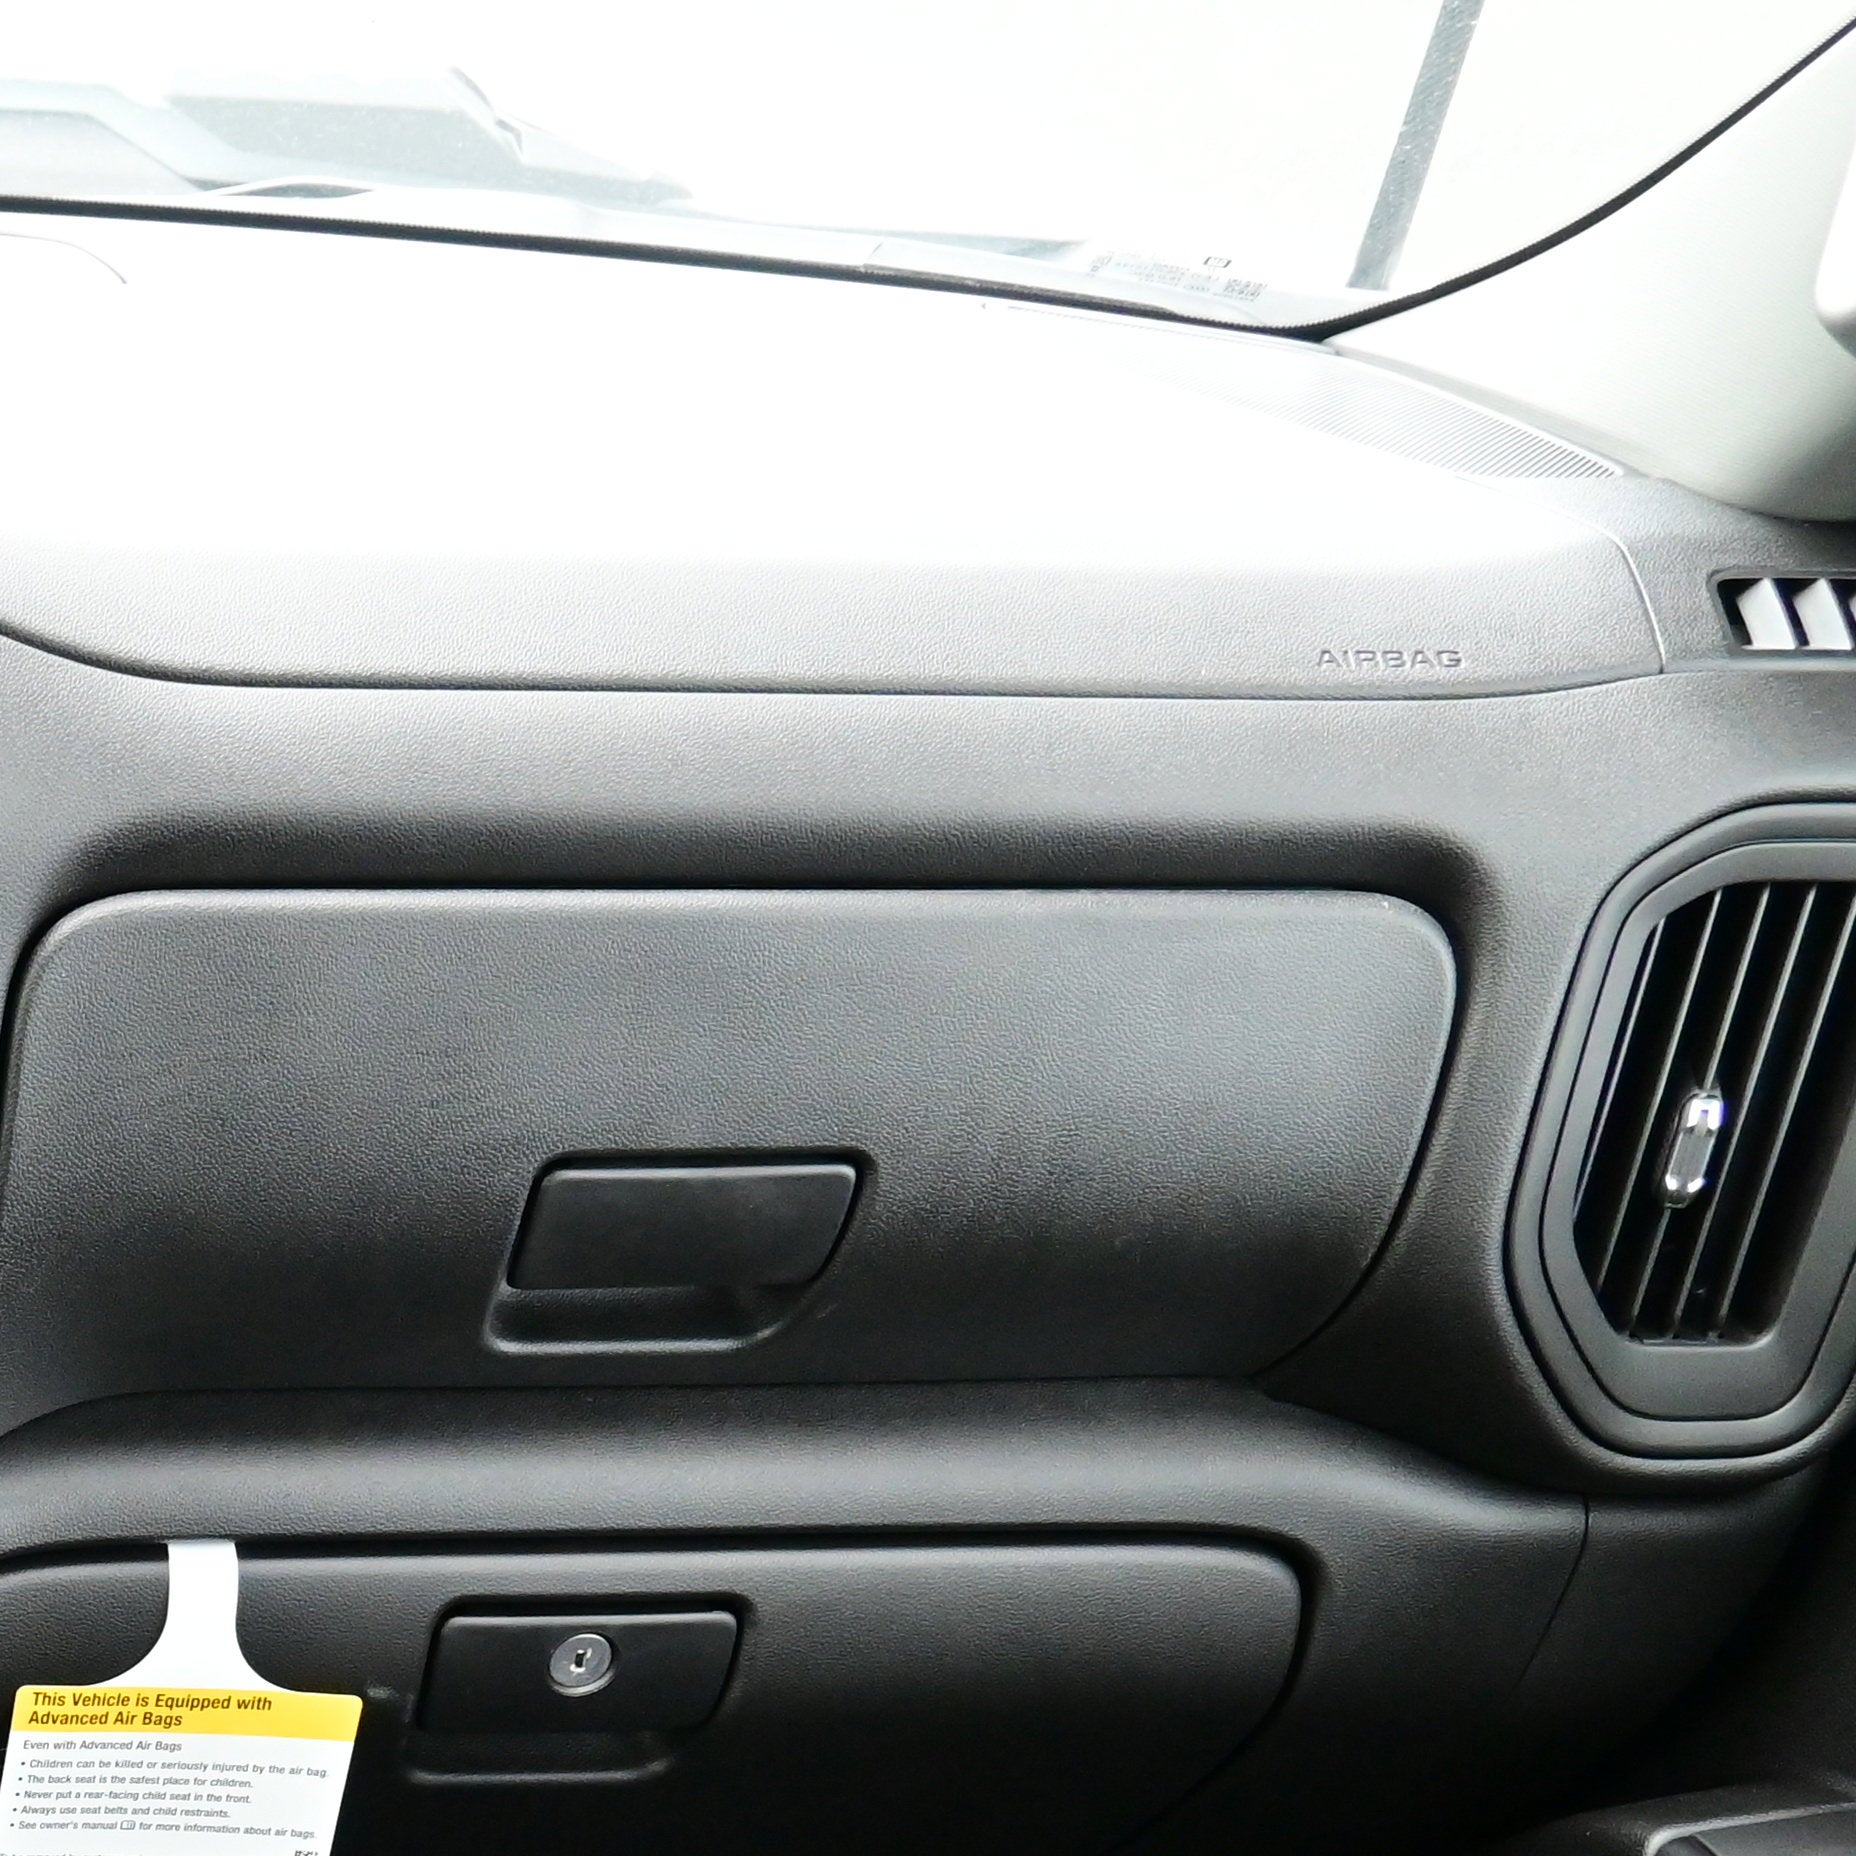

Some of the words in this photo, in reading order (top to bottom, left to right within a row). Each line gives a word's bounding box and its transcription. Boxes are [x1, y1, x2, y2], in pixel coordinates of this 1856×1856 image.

[1317, 649, 1463, 669] AIRBAG
[33, 1691, 66, 1707] This
[72, 1692, 131, 1708] Vehicle
[135, 1693, 150, 1707] is
[154, 1693, 232, 1712] Equipped
[237, 1695, 273, 1711] with
[28, 1710, 110, 1726] Advanced
[113, 1711, 138, 1726] Air
[142, 1711, 184, 1730] Bags
[23, 1740, 50, 1750] Even
[53, 1740, 77, 1750] with
[79, 1740, 134, 1751] Advanced
[136, 1740, 153, 1751] Air
[155, 1741, 183, 1753] Bags
[29, 1759, 73, 1769] Children
[76, 1760, 95, 1769] can
[98, 1759, 112, 1769] be
[114, 1759, 144, 1769] killed
[146, 1761, 158, 1770] or
[160, 1760, 209, 1773] seriously
[211, 1761, 250, 1774] injured
[252, 1763, 266, 1775] by
[268, 1764, 286, 1775] the
[288, 1766, 304, 1776] air
[27, 1774, 45, 1784] The
[48, 1774, 72, 1785] back
[75, 1775, 97, 1785] seat
[99, 1775, 108, 1785] is
[110, 1775, 127, 1785] the
[129, 1775, 160, 1785] safest
[162, 1776, 191, 1787] place
[193, 1776, 208, 1787] for
[23, 1790, 54, 1800] Never
[56, 1790, 73, 1801] put
[84, 1790, 140, 1801] rear-facing
[142, 1791, 167, 1801] child
[169, 1791, 191, 1802] seat
[193, 1791, 203, 1802] in
[206, 1792, 223, 1803] the
[20, 1805, 57, 1815] Always
[59, 1807, 77, 1815] use
[80, 1805, 102, 1815] seat
[103, 1805, 129, 1816] belts
[131, 1806, 150, 1816] and
[152, 1807, 178, 1817] child
[18, 1820, 37, 1830] See
[39, 1821, 79, 1830] owner's
[81, 1821, 118, 1831] manual
[139, 1821, 154, 1831] for
[155, 1824, 181, 1832] more
[183, 1823, 241, 1834] information
[243, 1826, 272, 1837] about
[274, 1828, 289, 1838] air
